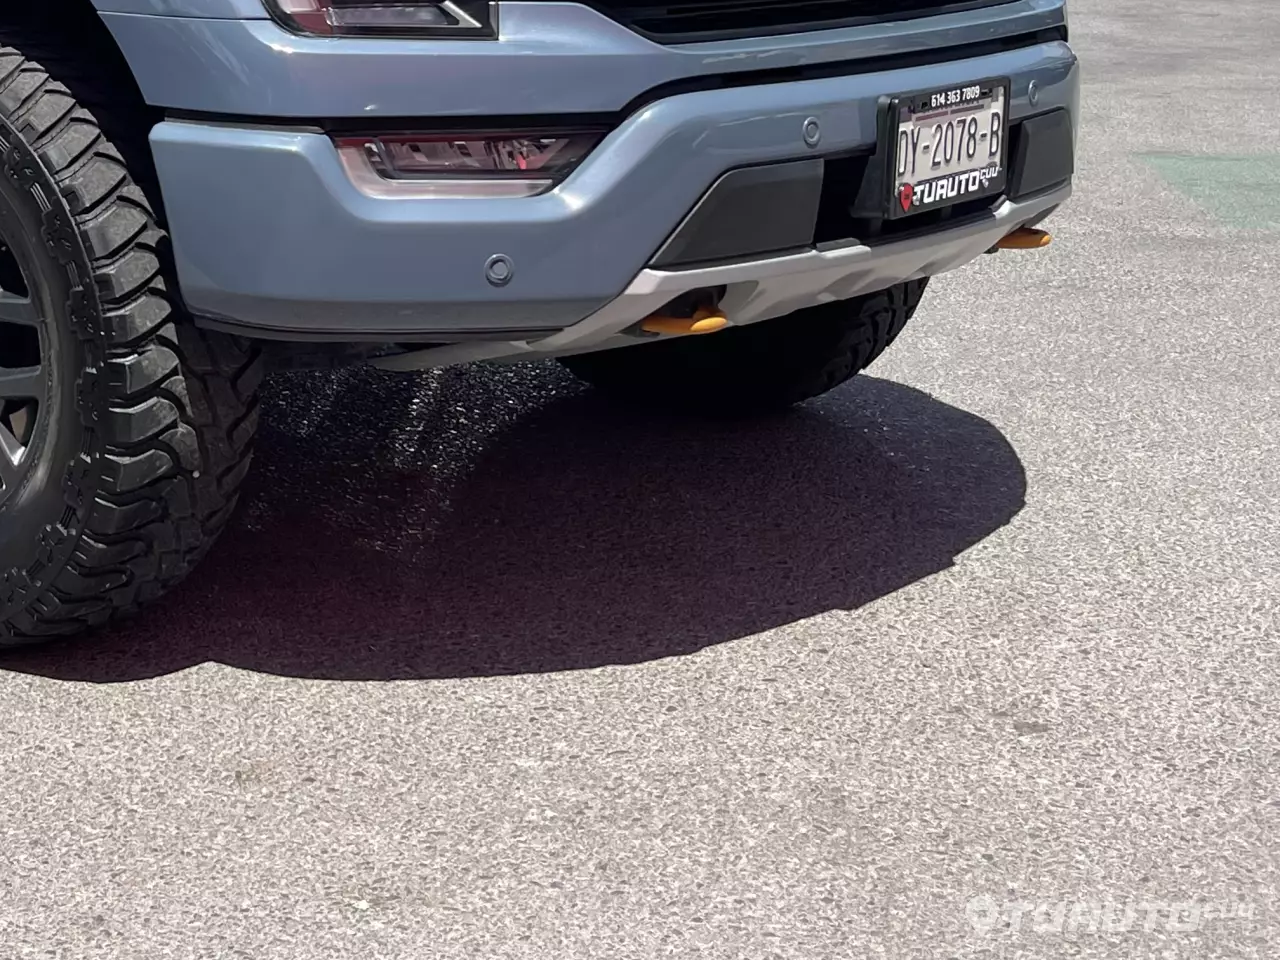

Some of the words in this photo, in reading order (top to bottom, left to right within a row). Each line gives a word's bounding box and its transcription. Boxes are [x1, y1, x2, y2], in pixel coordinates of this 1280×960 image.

[931, 93, 946, 108] 614
[897, 111, 1002, 177] DY-2078-B
[913, 170, 980, 204] TUAUTO
